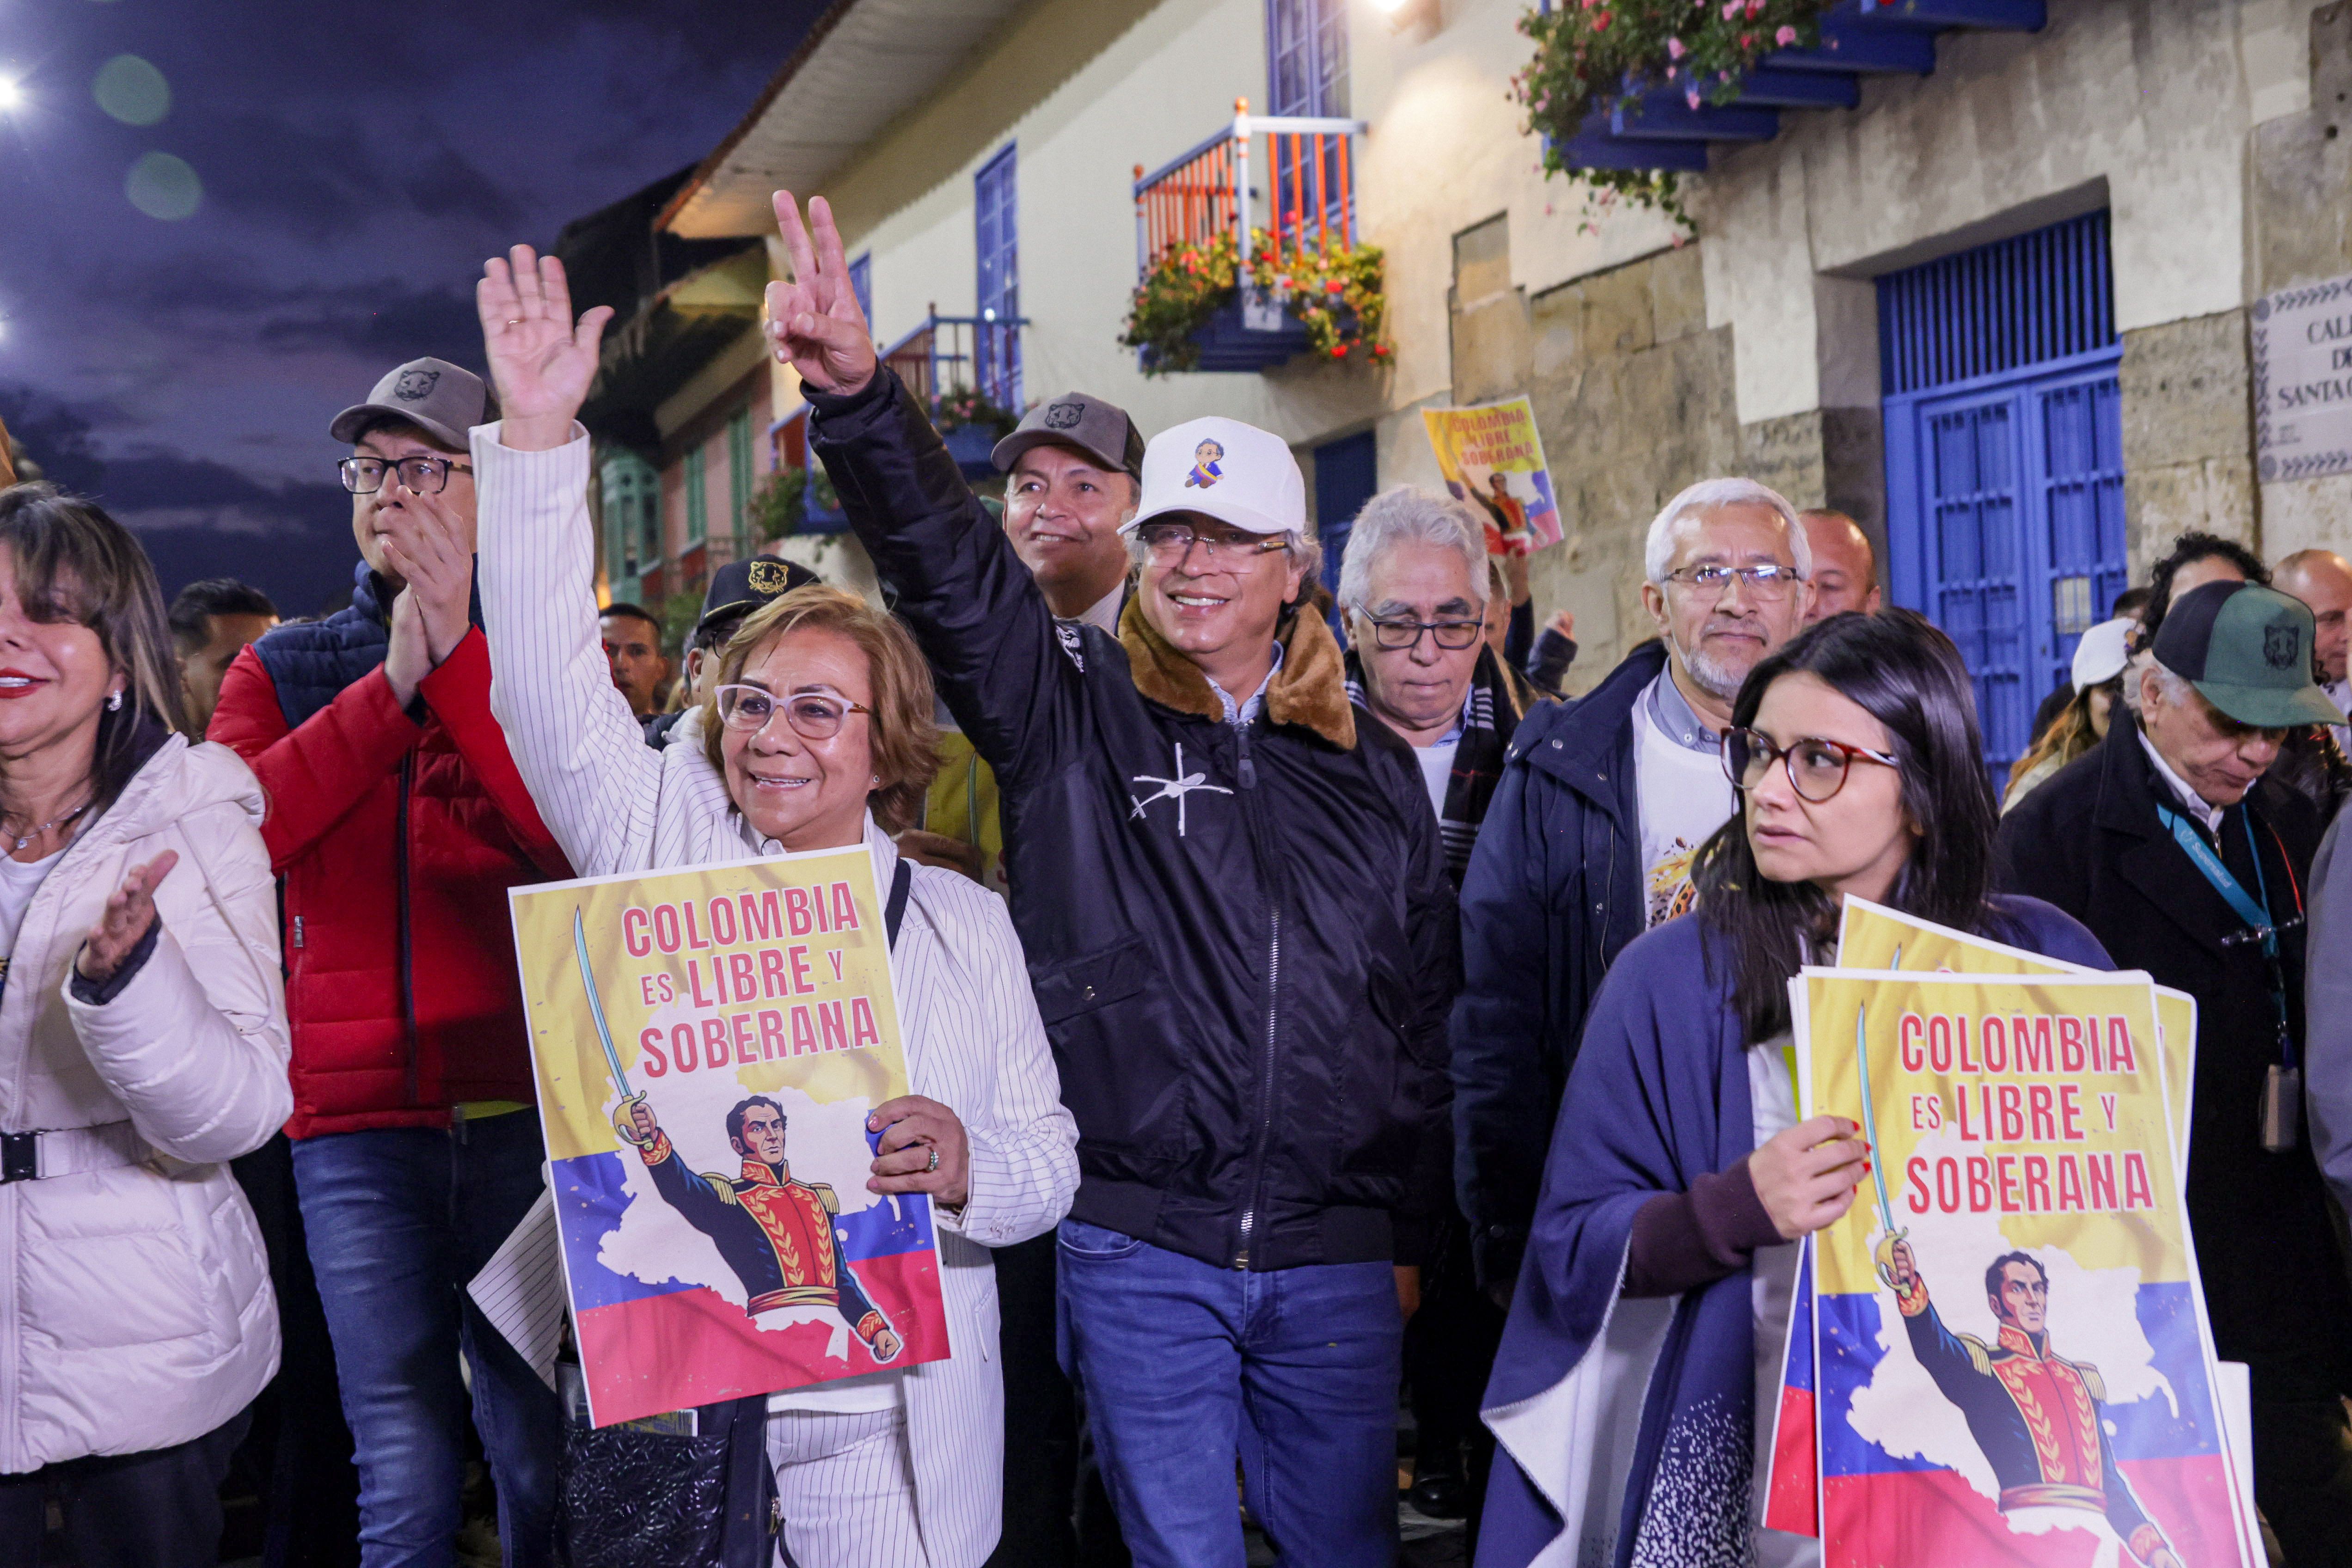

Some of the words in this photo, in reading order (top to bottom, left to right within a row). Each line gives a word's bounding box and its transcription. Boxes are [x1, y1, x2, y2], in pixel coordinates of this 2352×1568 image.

[2308, 315, 2352, 343] CAL
[1451, 408, 1525, 432] COLOMBIA
[2278, 379, 2344, 410] SANTA
[1461, 441, 1534, 465] SOBERANA
[624, 882, 858, 957] COLOMBIA
[642, 974, 673, 1005] ES
[688, 946, 815, 1008] LIBRE
[828, 950, 841, 980] Y
[641, 998, 879, 1078] SOBERANA
[1901, 1015, 2135, 1073] COLOMBIA
[1912, 1096, 1941, 1130] ES
[1958, 1085, 2084, 1141] LIBRE
[2101, 1096, 2115, 1129] Y
[1907, 1153, 2153, 1215] SOBERANA
